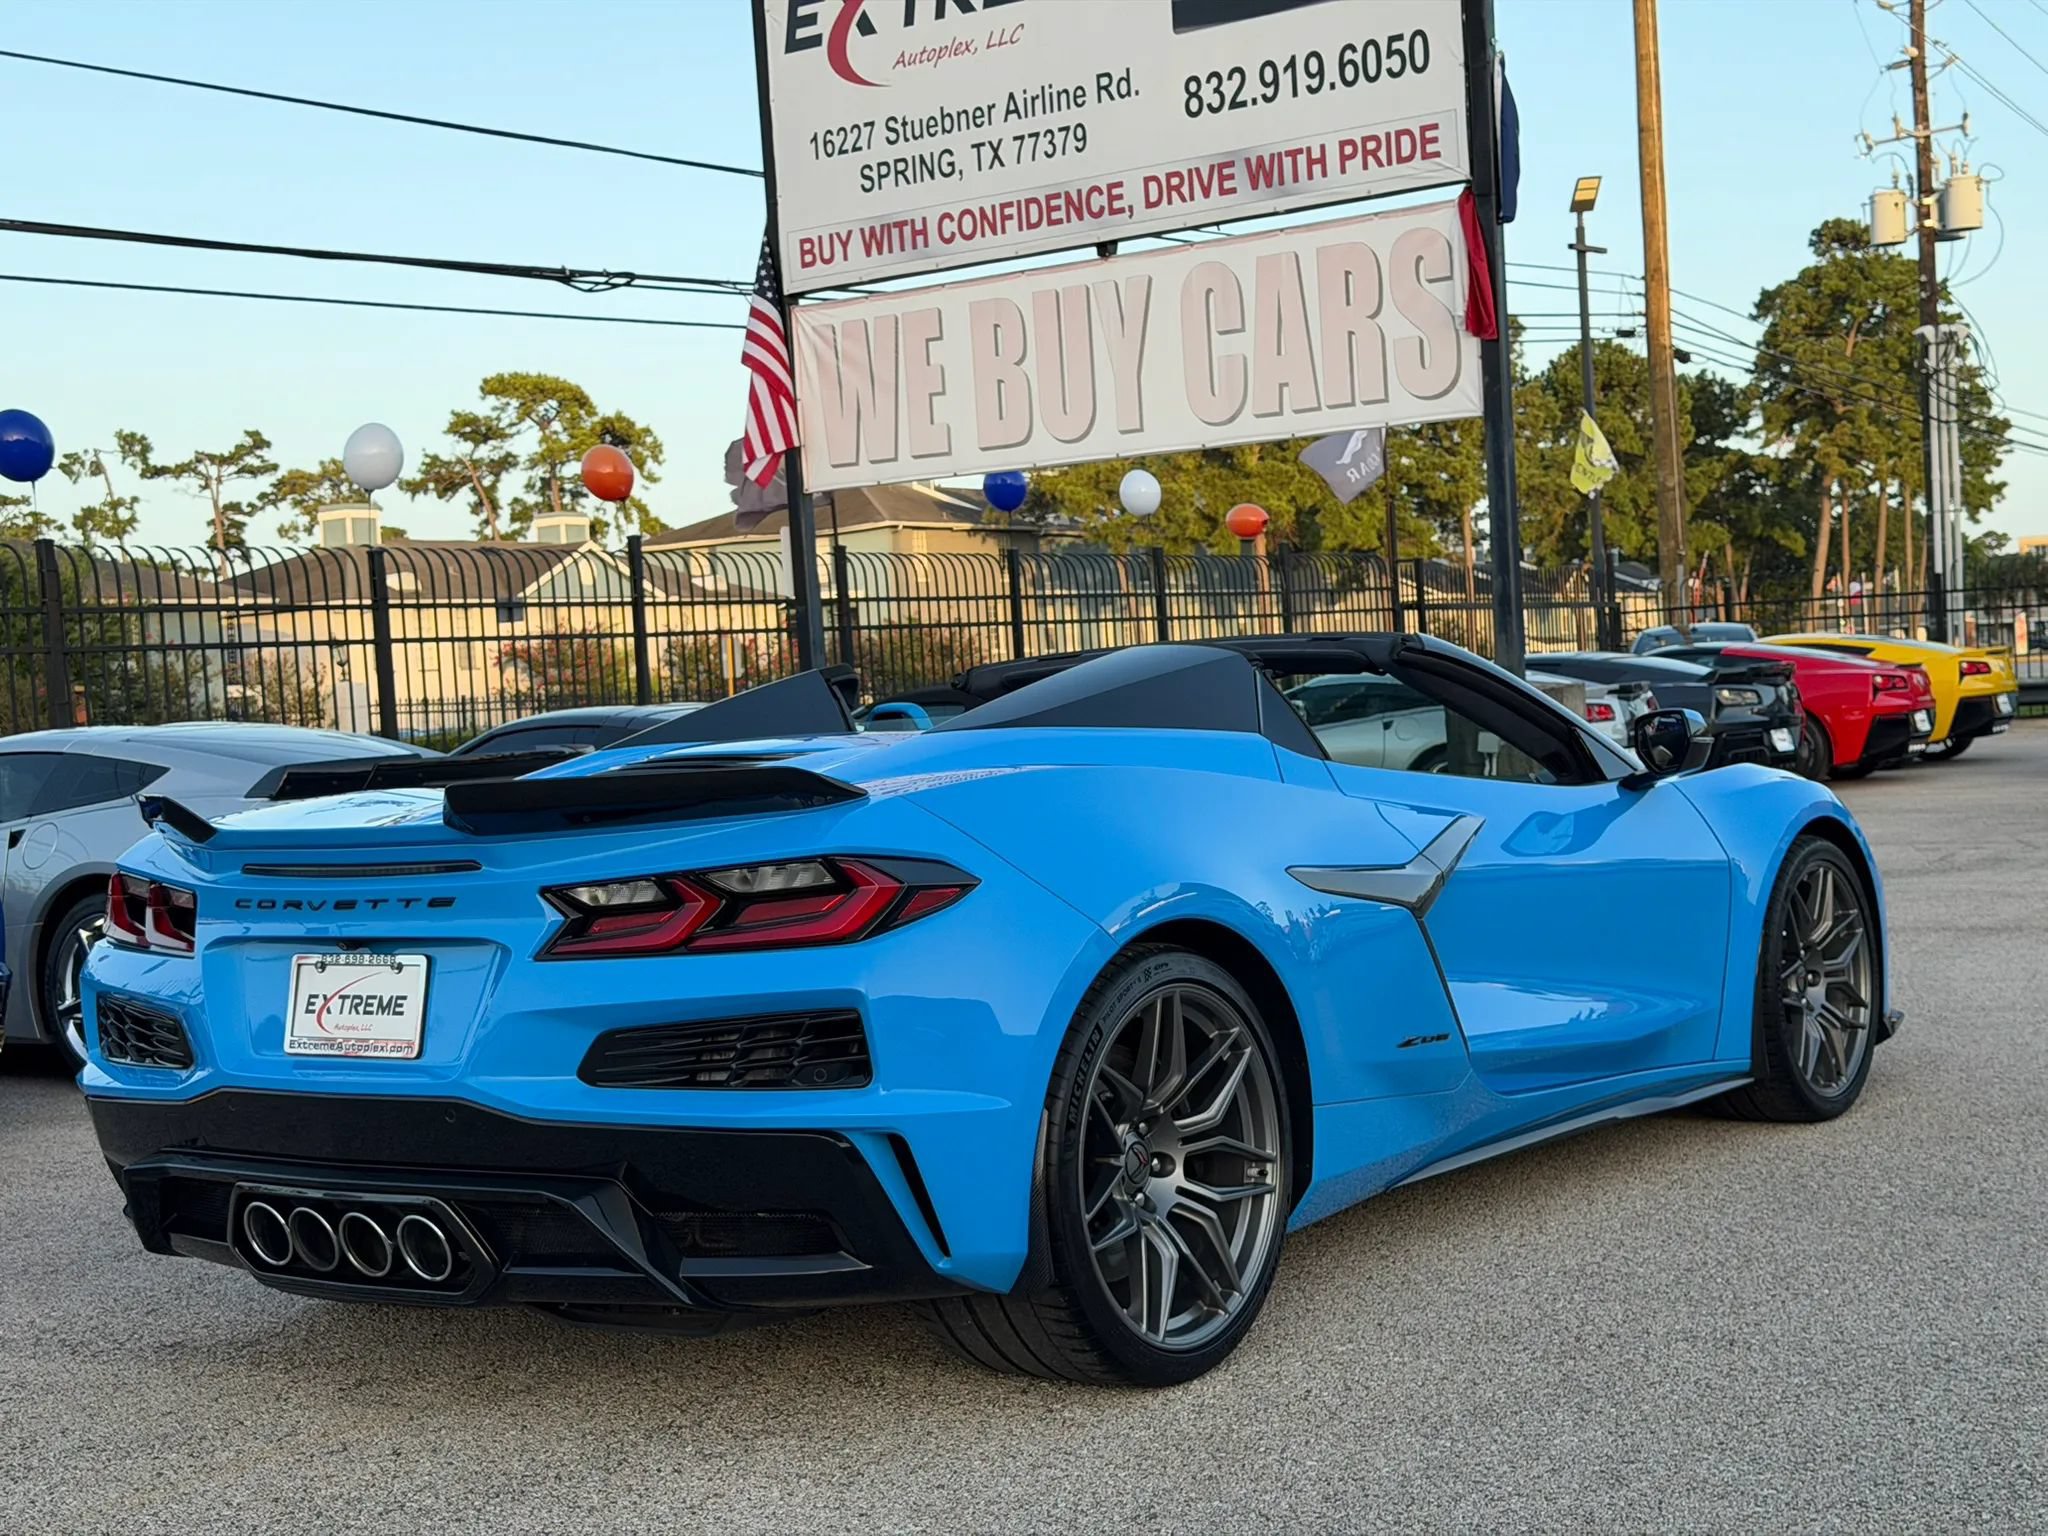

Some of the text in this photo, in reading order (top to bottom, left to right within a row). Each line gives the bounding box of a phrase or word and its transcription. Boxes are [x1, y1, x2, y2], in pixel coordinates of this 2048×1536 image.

[891, 36, 978, 70] Autoplex,
[985, 23, 1025, 50] LLC
[1182, 28, 1430, 119] 832.919.6050
[808, 67, 1140, 161] 16227 Stuebner Airline Rd.
[860, 122, 1088, 194] SPRING, TX 77379
[798, 122, 1442, 270] BUY WITH CONFIDENCE, DRIVE WITH PRIDE
[824, 226, 1463, 468] WE BUY CARS
[235, 896, 457, 911] CORVETTE
[304, 993, 409, 1017] EXTREME
[1067, 1025, 1103, 1125] MICHELIN
